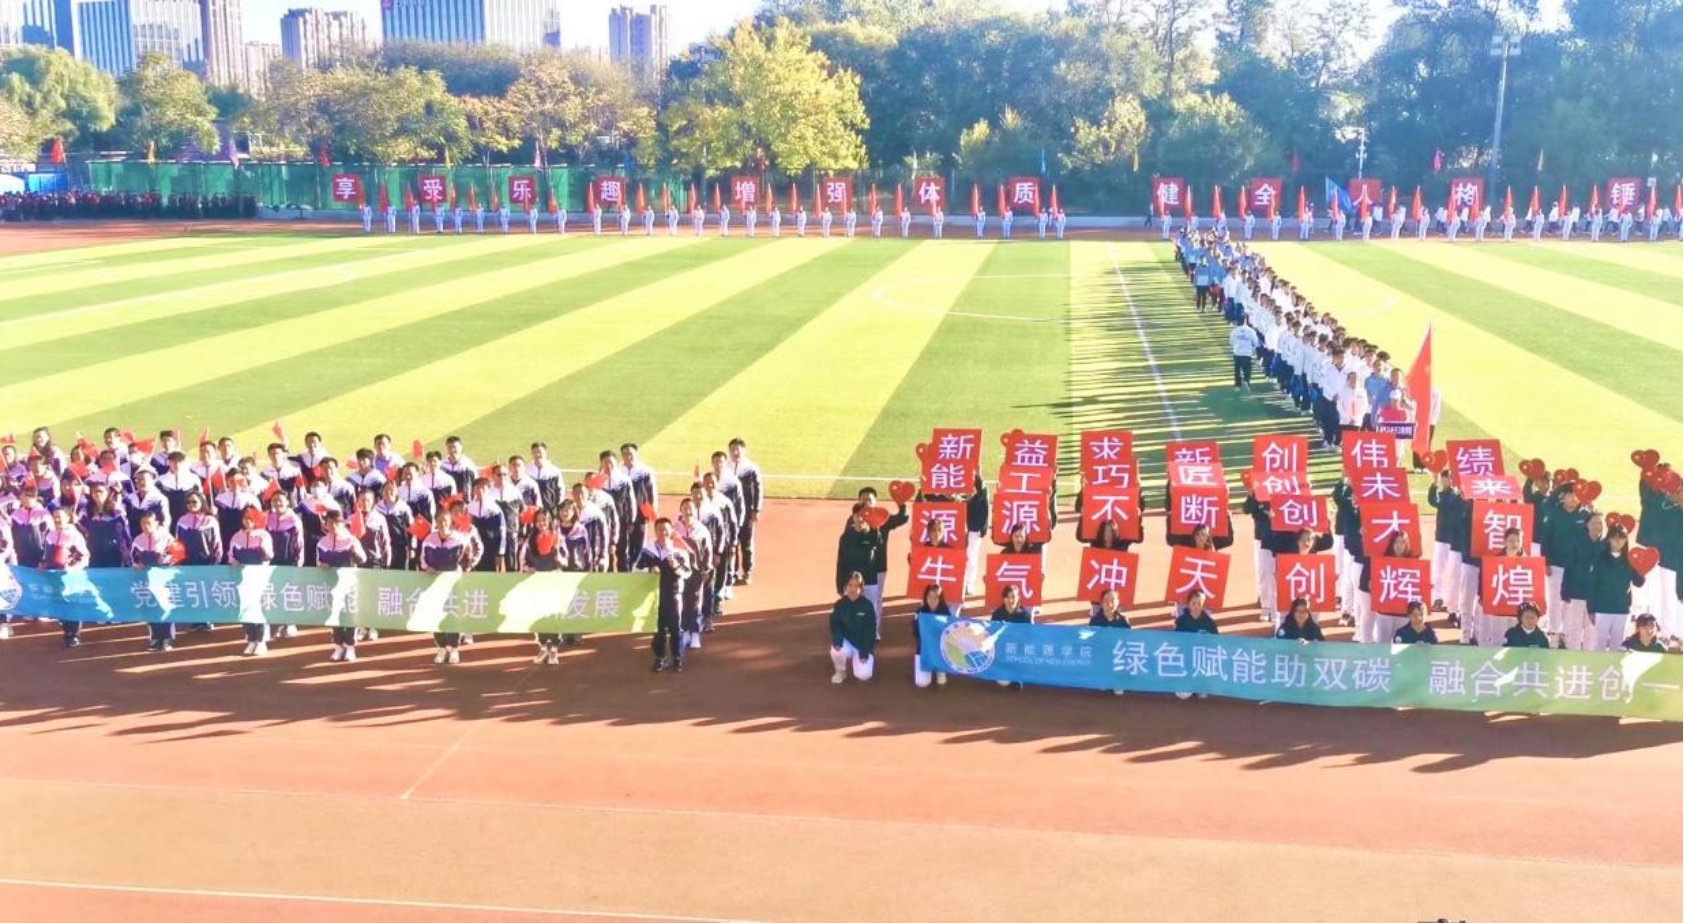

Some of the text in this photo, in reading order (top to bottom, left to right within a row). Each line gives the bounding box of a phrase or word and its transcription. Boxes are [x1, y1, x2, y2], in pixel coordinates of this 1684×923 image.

[336, 178, 356, 199] 享
[735, 181, 755, 202] 增
[827, 182, 846, 202] 强
[919, 182, 940, 203] 体
[1013, 182, 1036, 203] 质
[1157, 183, 1180, 205] 健
[1255, 183, 1276, 206] 全
[938, 434, 975, 460] 新
[1011, 439, 1048, 467] 益
[1089, 437, 1123, 459] 求
[1262, 442, 1297, 473] 创
[1351, 439, 1388, 468] 伟
[1178, 465, 1218, 486] 匠
[1456, 447, 1495, 476] 绩
[930, 463, 965, 489] 能
[1004, 472, 1043, 494] 工
[1092, 465, 1130, 489] 巧
[1262, 476, 1300, 496] 创
[1001, 501, 1040, 534] 源
[1091, 496, 1130, 520] 不
[1180, 494, 1219, 528] 断
[1279, 499, 1318, 527] 创
[920, 510, 958, 543] 源
[1483, 510, 1523, 549] 智
[917, 555, 956, 584] 牛
[996, 561, 1033, 598] 气
[1087, 558, 1127, 590] 冲
[1175, 556, 1218, 598] 天
[1285, 562, 1325, 603] 创
[1380, 565, 1422, 603] 辉
[1491, 565, 1534, 606] 煌
[1112, 640, 1392, 692] 绿色赋能助双碳
